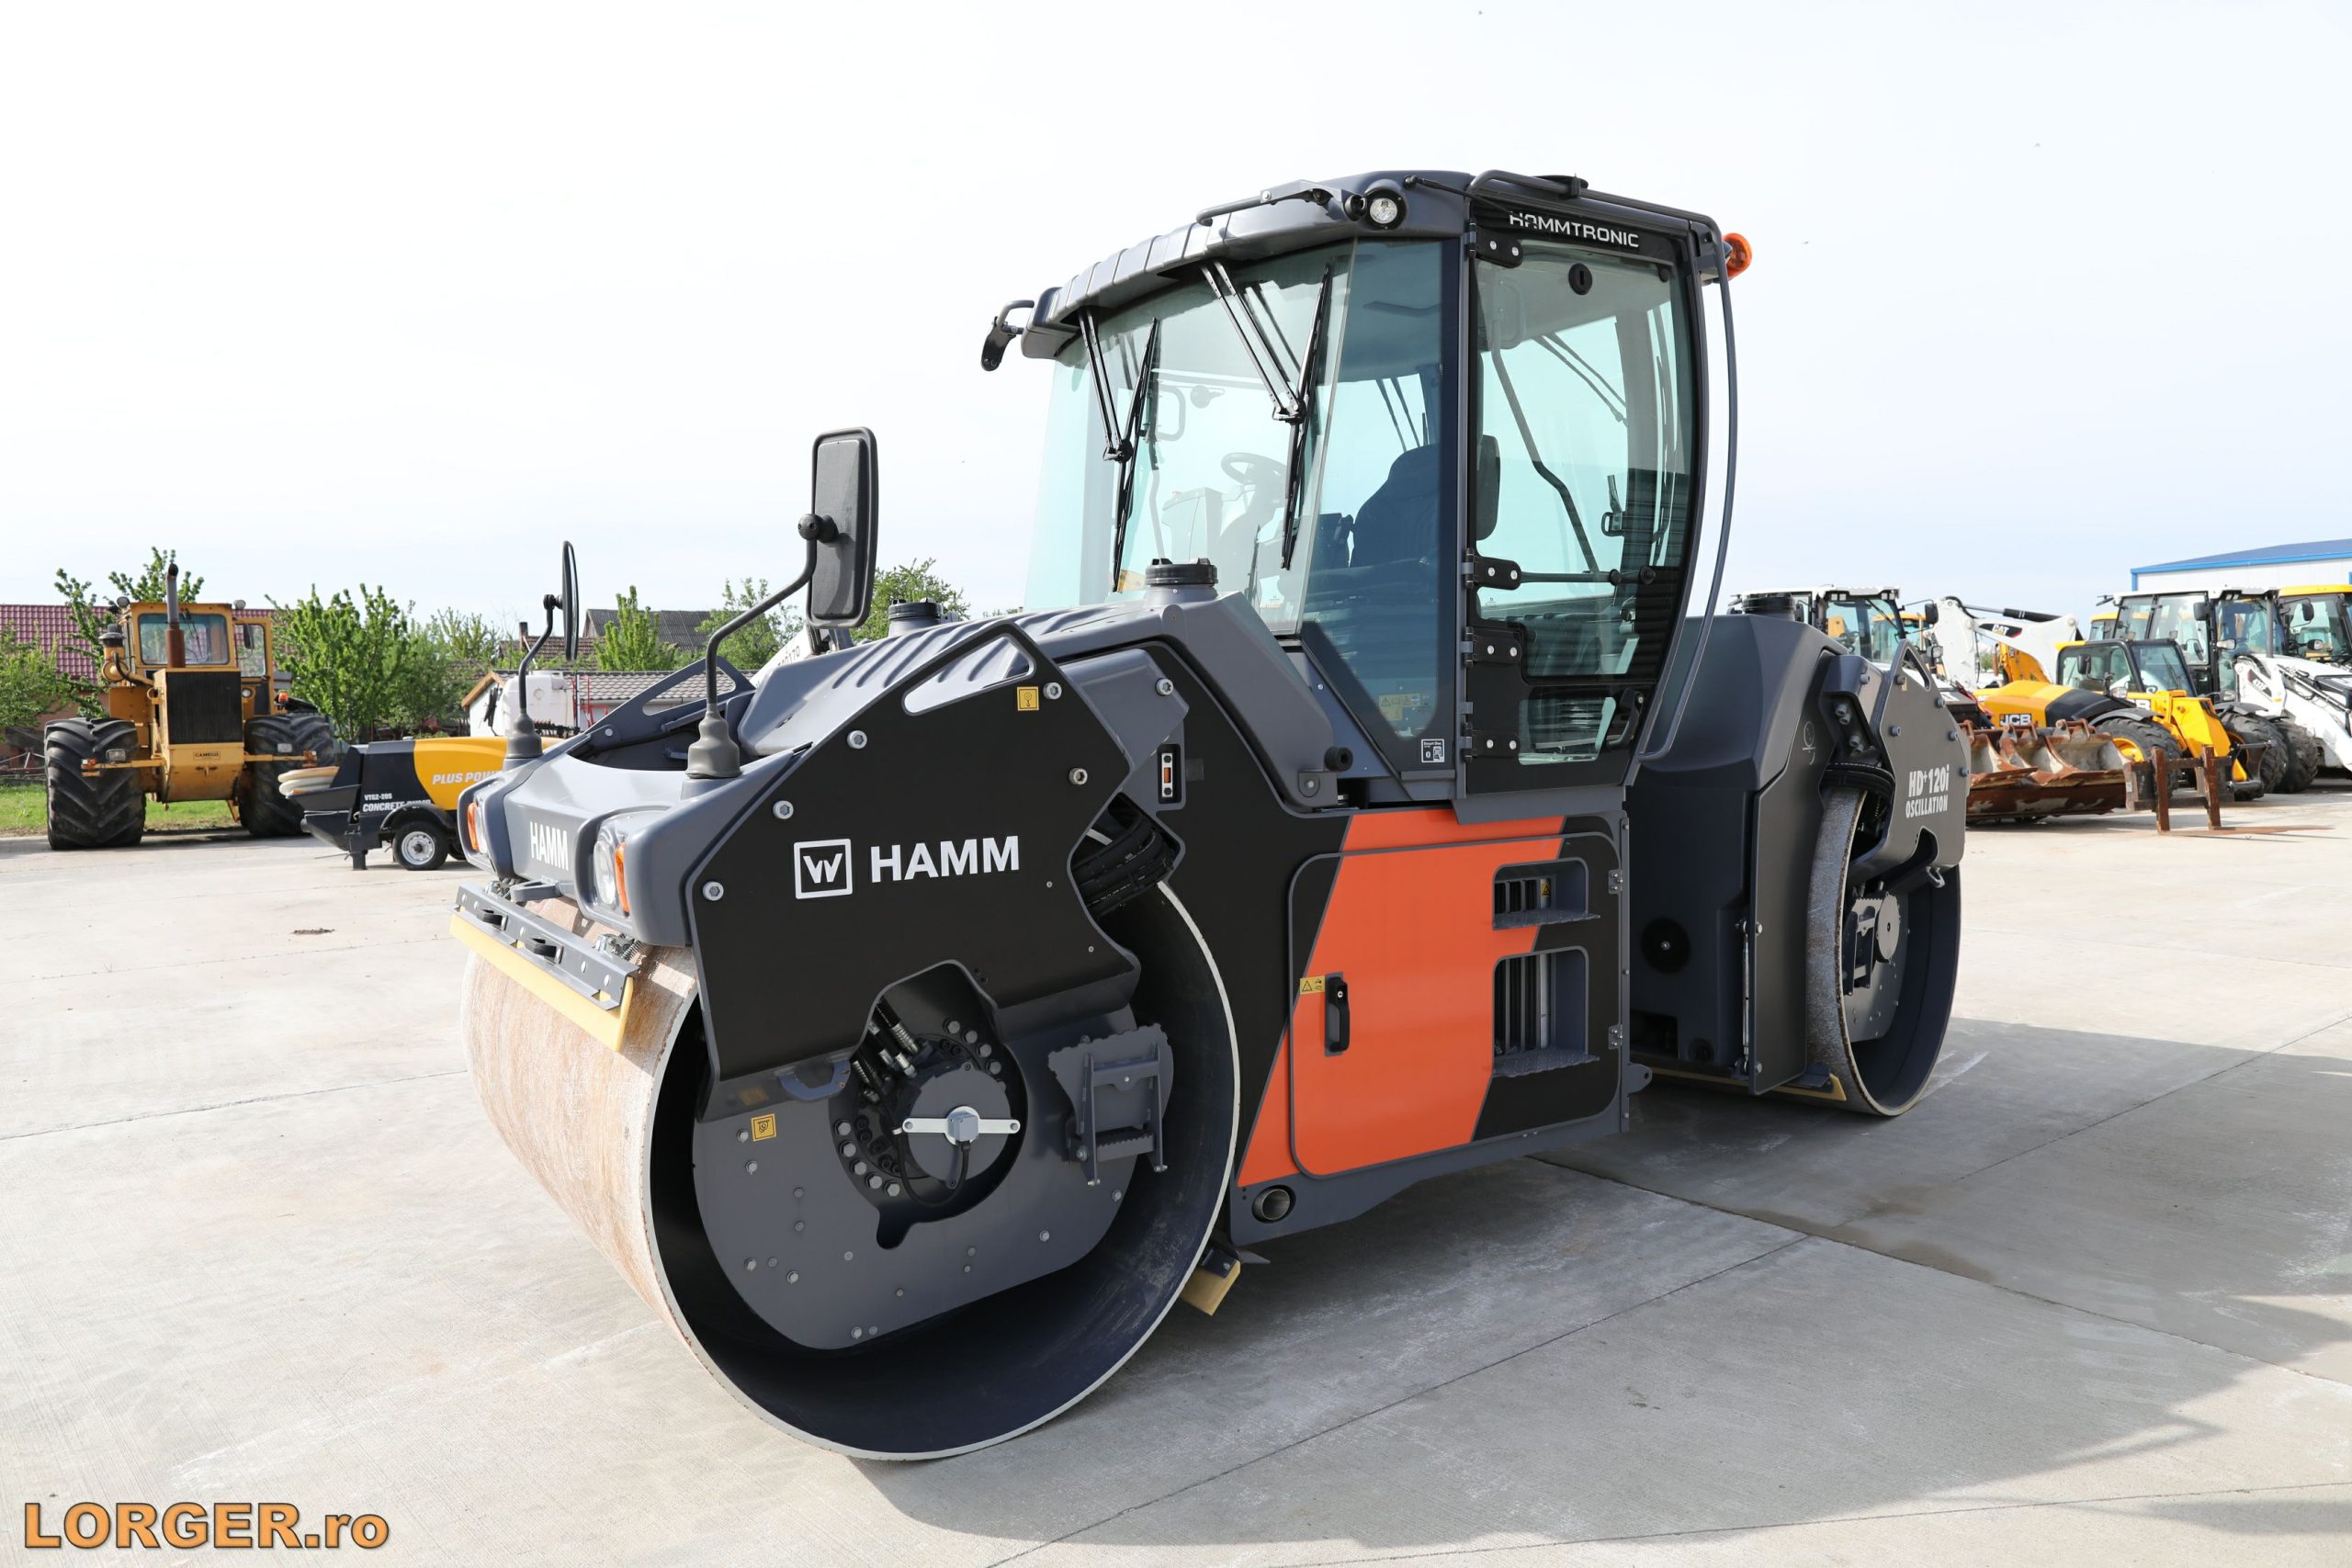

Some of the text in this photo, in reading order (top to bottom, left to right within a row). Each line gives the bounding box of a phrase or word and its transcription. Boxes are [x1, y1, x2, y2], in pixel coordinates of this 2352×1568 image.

[1510, 212, 1640, 248] HAMMTRONIC
[1992, 625, 2009, 636] CAT
[1999, 714, 2031, 726] JCB
[432, 773, 463, 784] PLUS
[1905, 794, 1949, 818] OSCILLATION
[529, 821, 569, 871] HAMM
[870, 835, 1020, 884] HAMM
